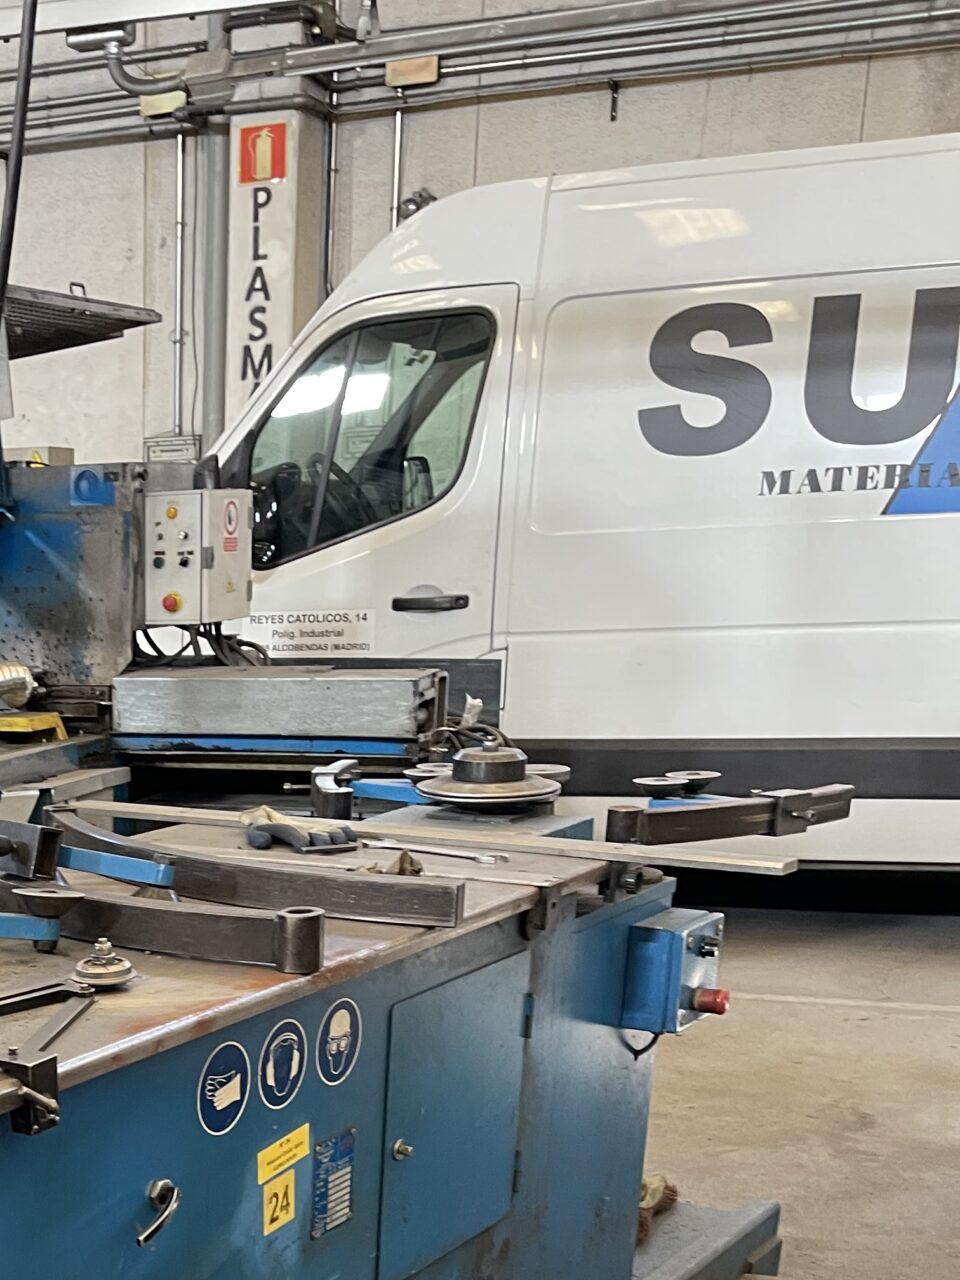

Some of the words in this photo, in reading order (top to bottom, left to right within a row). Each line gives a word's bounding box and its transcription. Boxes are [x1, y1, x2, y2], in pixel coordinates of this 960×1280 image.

[241, 186, 273, 400] PLASM
[250, 614, 284, 624] REYES
[287, 613, 352, 624] CATOLICOS,
[355, 613, 368, 621] 14
[299, 628, 344, 638] Industrial
[272, 643, 328, 652] ALCOBENDAS
[331, 643, 370, 652] (MADRID)
[268, 1184, 291, 1225] 24
